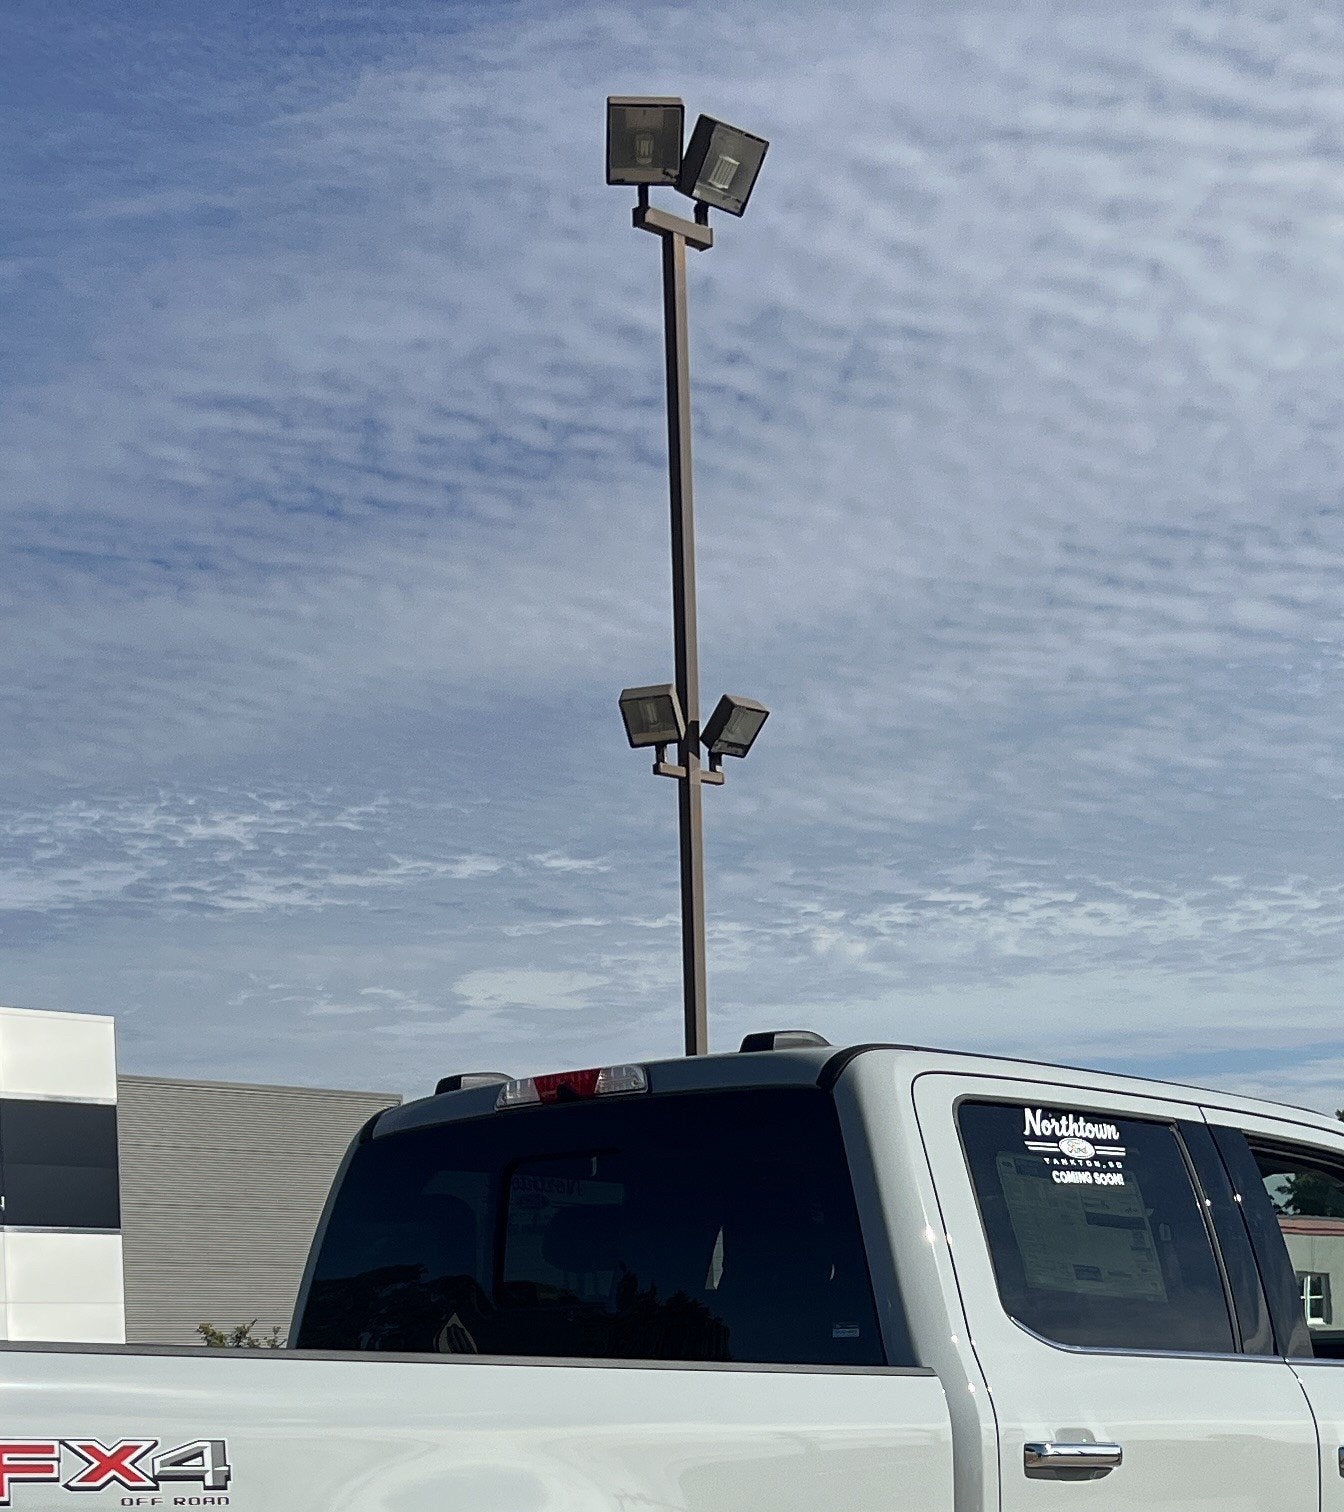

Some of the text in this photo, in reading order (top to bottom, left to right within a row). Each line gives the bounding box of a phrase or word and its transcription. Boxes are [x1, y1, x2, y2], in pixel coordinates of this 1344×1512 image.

[1023, 1107, 1120, 1141] Northtown
[1052, 1170, 1093, 1185] COMING
[120, 1495, 230, 1507] OFF ROAD
